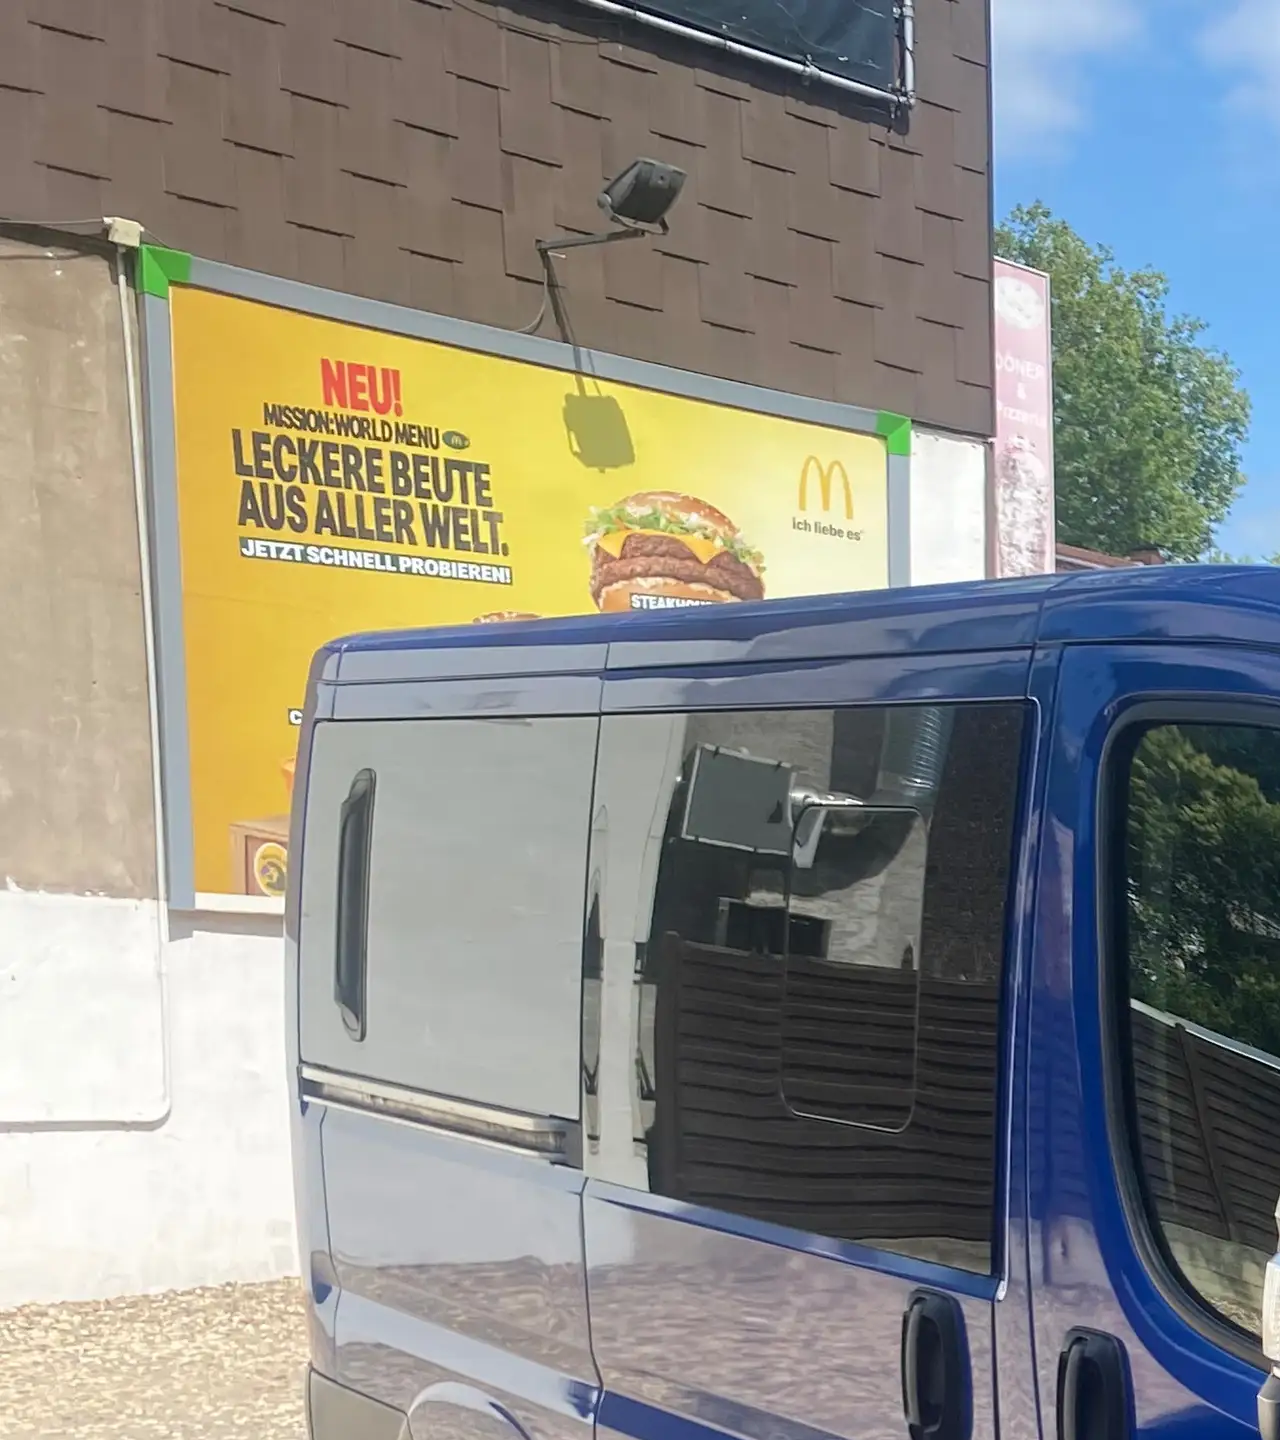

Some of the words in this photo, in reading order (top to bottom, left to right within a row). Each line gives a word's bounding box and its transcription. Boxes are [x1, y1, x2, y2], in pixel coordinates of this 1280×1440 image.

[321, 358, 403, 416] NEU!
[263, 402, 393, 443] MISSION:WORLD
[395, 423, 440, 450] MENU
[231, 428, 386, 494] LECKERE
[390, 450, 494, 507] BEUTE
[238, 479, 308, 534] AUS
[314, 489, 418, 547] ALLER
[418, 502, 510, 557] WELT.
[792, 517, 812, 533] ich
[814, 521, 845, 539] liebe
[241, 538, 304, 561] JETZT
[306, 545, 398, 572] SCHNELL
[399, 559, 511, 584] PROBIEREN!
